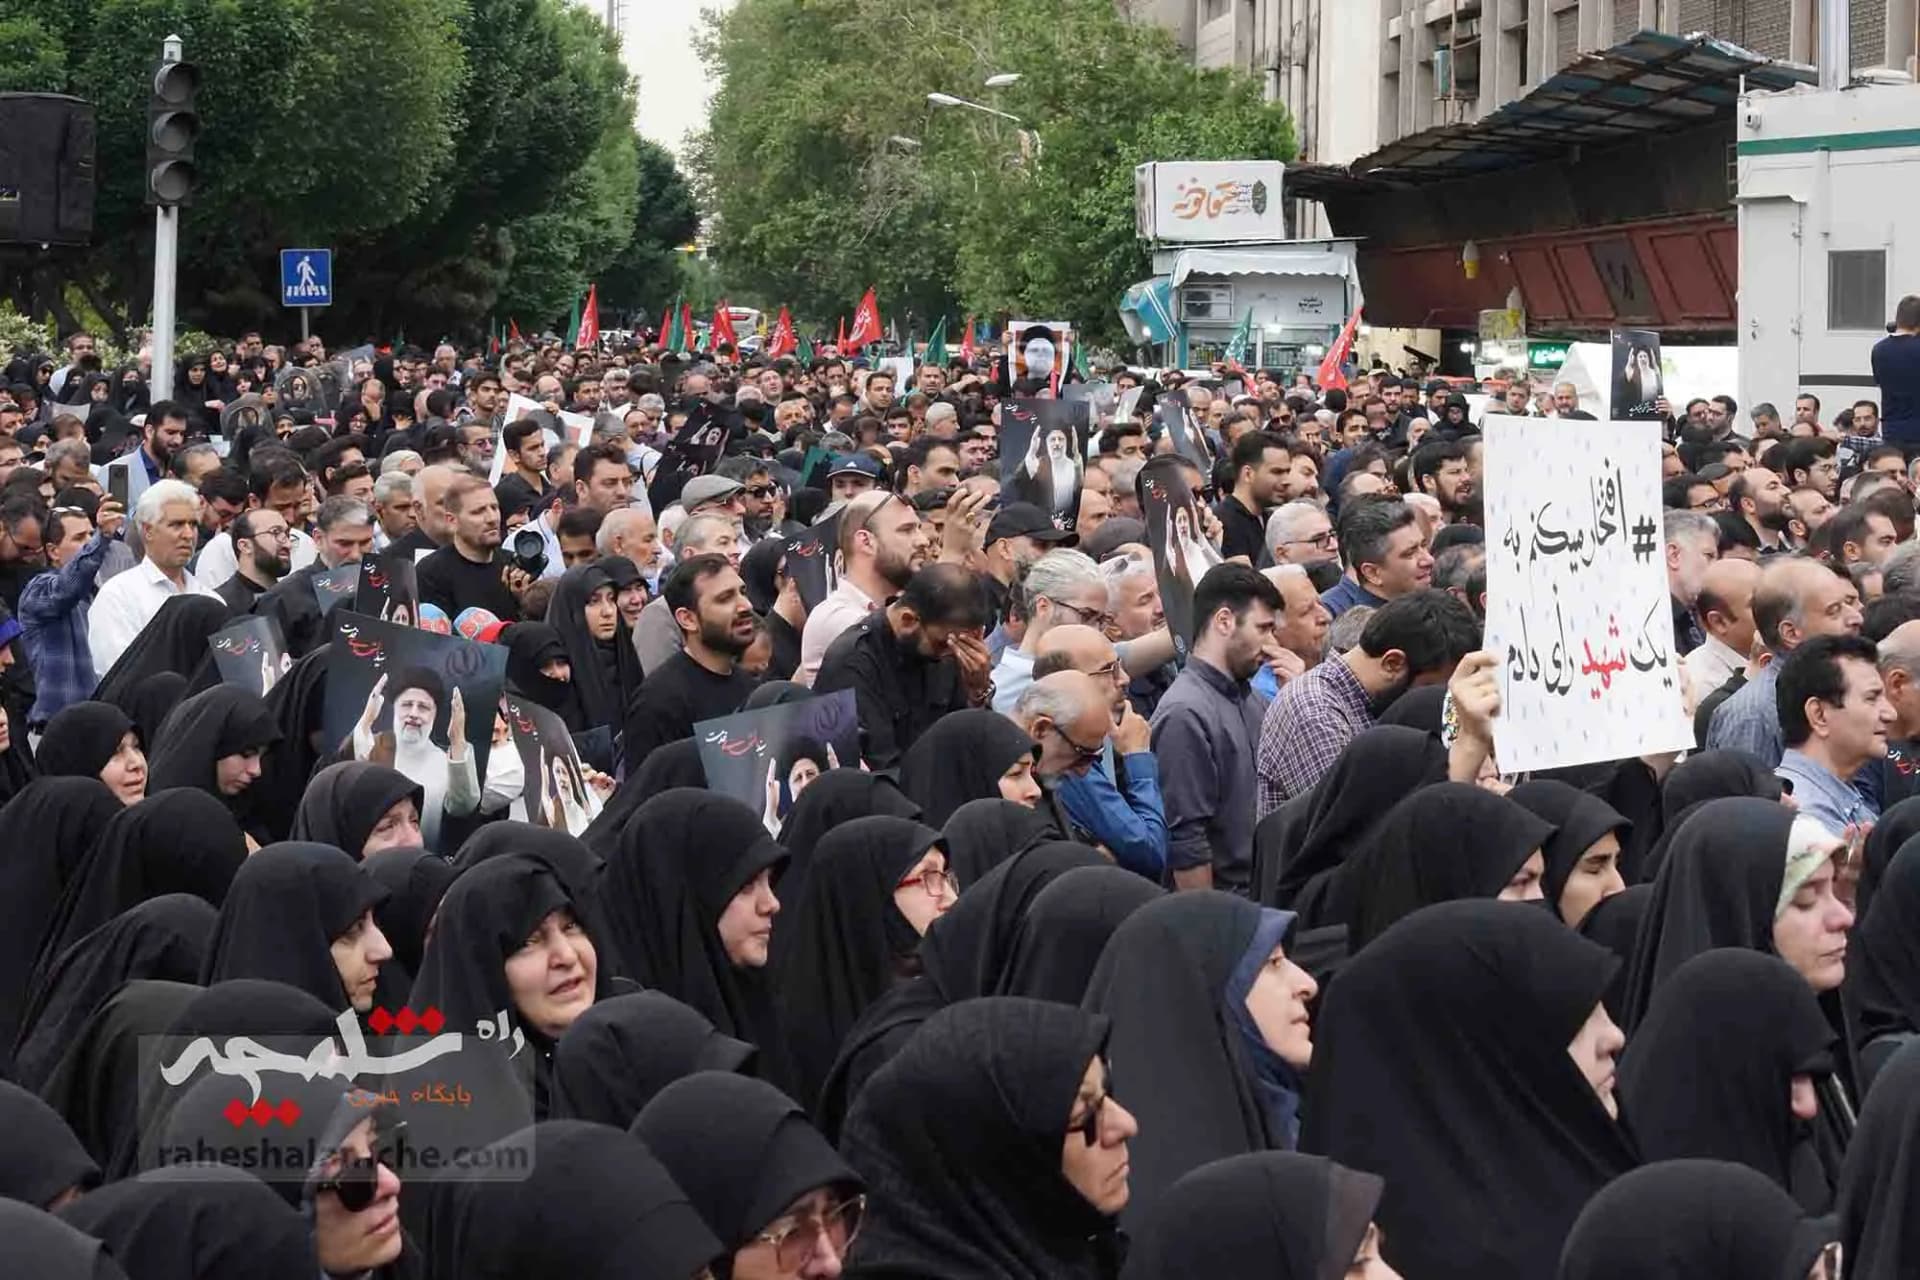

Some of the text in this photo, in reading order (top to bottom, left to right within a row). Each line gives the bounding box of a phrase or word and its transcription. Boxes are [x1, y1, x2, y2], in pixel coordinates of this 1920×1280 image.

[1503, 513, 1521, 573] به
[1506, 603, 1540, 721] دادم
[1581, 613, 1627, 700] شهید
[1629, 598, 1672, 688] یک
